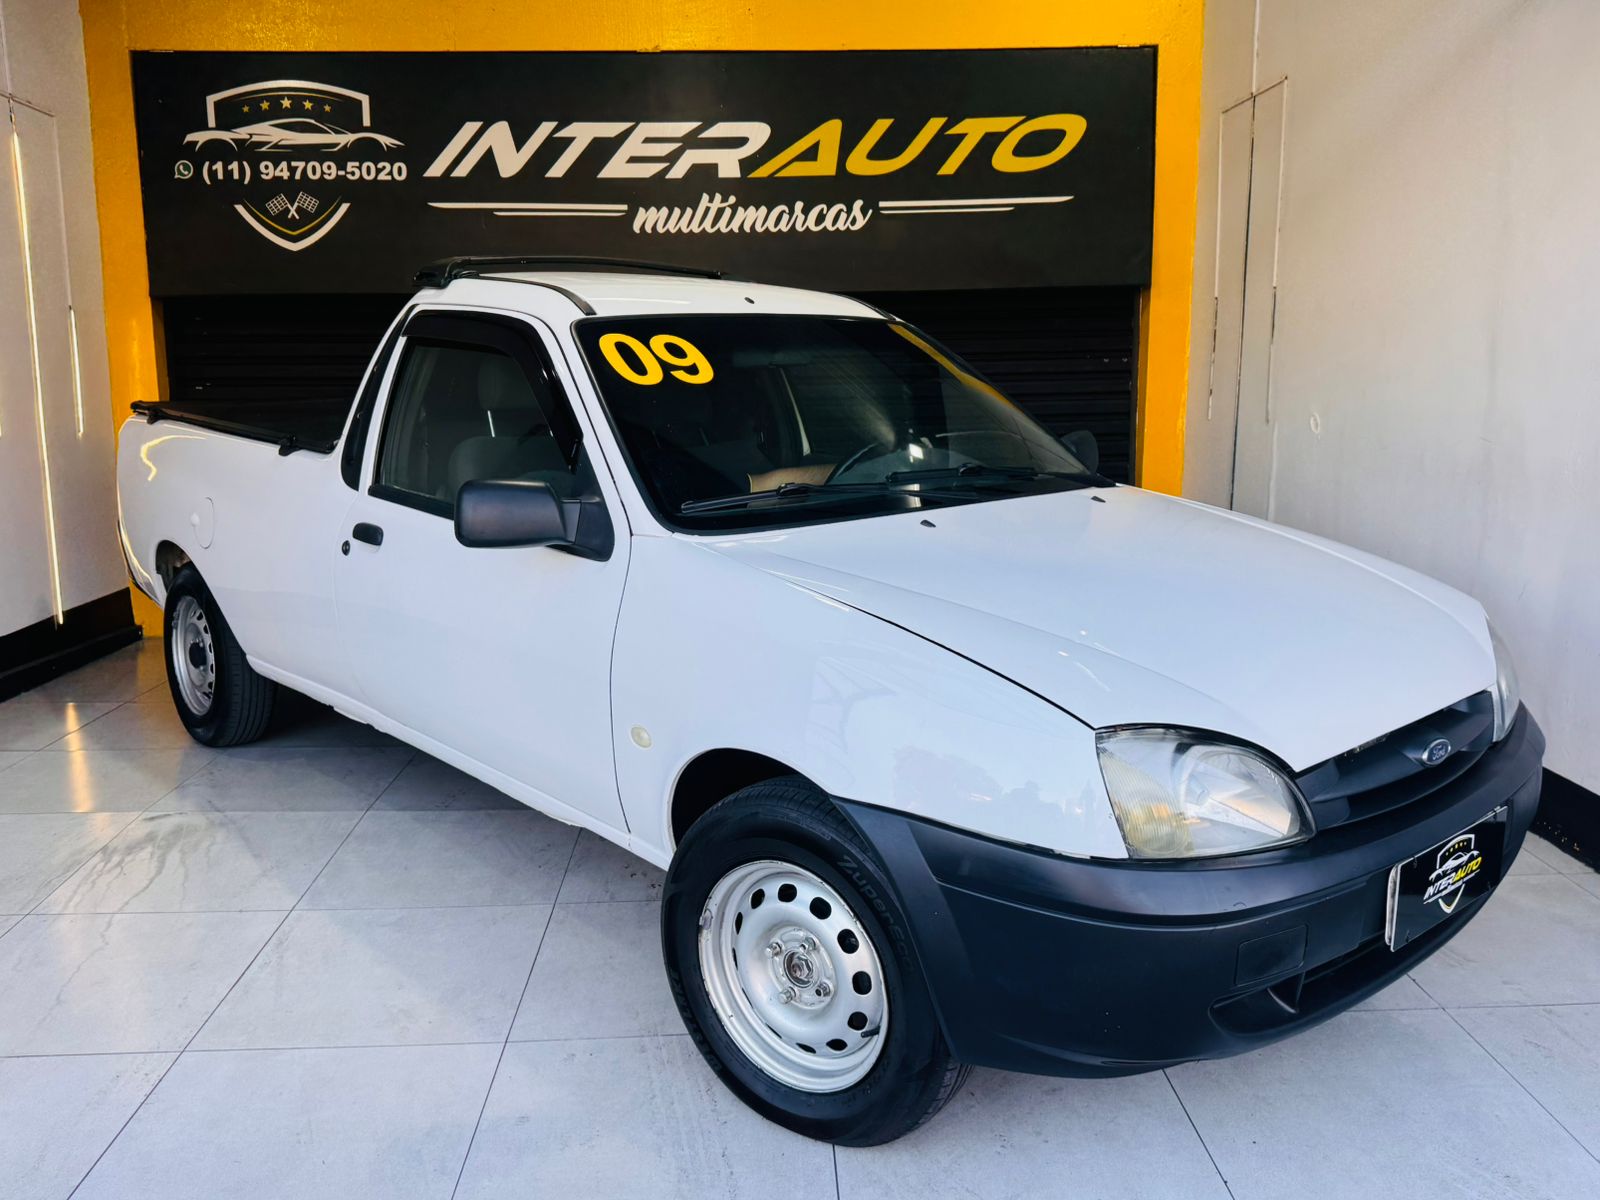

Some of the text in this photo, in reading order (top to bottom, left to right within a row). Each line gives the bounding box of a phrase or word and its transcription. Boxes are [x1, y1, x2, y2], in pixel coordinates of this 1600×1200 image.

[423, 114, 1087, 179] INTERAUTO
[203, 161, 407, 184] (11) 94709-5020
[633, 193, 872, 233] multimarcas
[598, 333, 714, 386] 09
